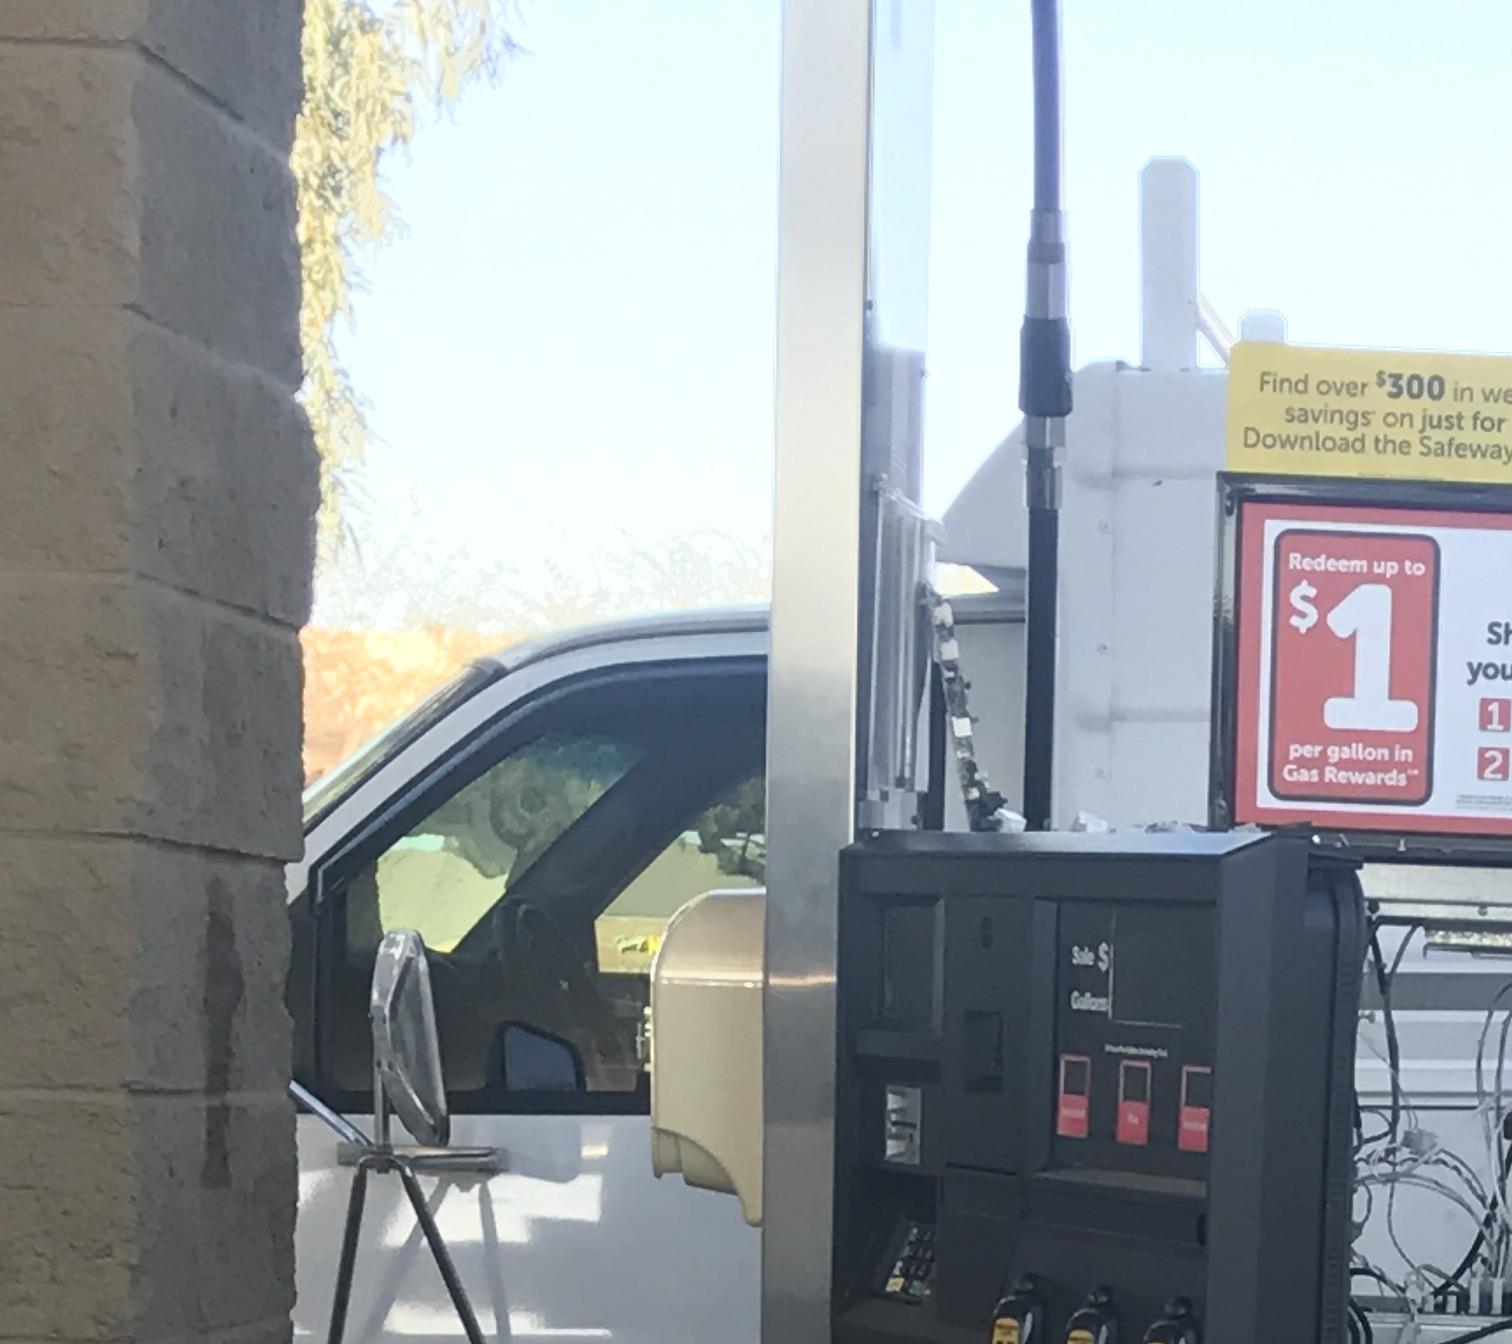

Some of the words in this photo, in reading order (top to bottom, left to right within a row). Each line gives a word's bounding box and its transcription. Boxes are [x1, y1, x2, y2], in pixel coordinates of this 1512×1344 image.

[1259, 371, 1309, 394] Find
[1316, 379, 1369, 397] over
[1375, 370, 1446, 401] $300
[1453, 381, 1474, 402] in
[1382, 411, 1414, 429] on
[1418, 408, 1465, 434] just
[1472, 411, 1507, 433] for
[1243, 427, 1366, 455] Download
[1373, 434, 1412, 456] the
[1289, 553, 1368, 573] Redeem
[1373, 559, 1399, 578] up
[1404, 559, 1426, 576] to
[1487, 701, 1504, 731] 1
[1288, 743, 1323, 762] per
[1327, 742, 1389, 764] gallon
[1395, 743, 1414, 762] in
[1483, 750, 1503, 779] 2
[1282, 764, 1319, 783] Gas
